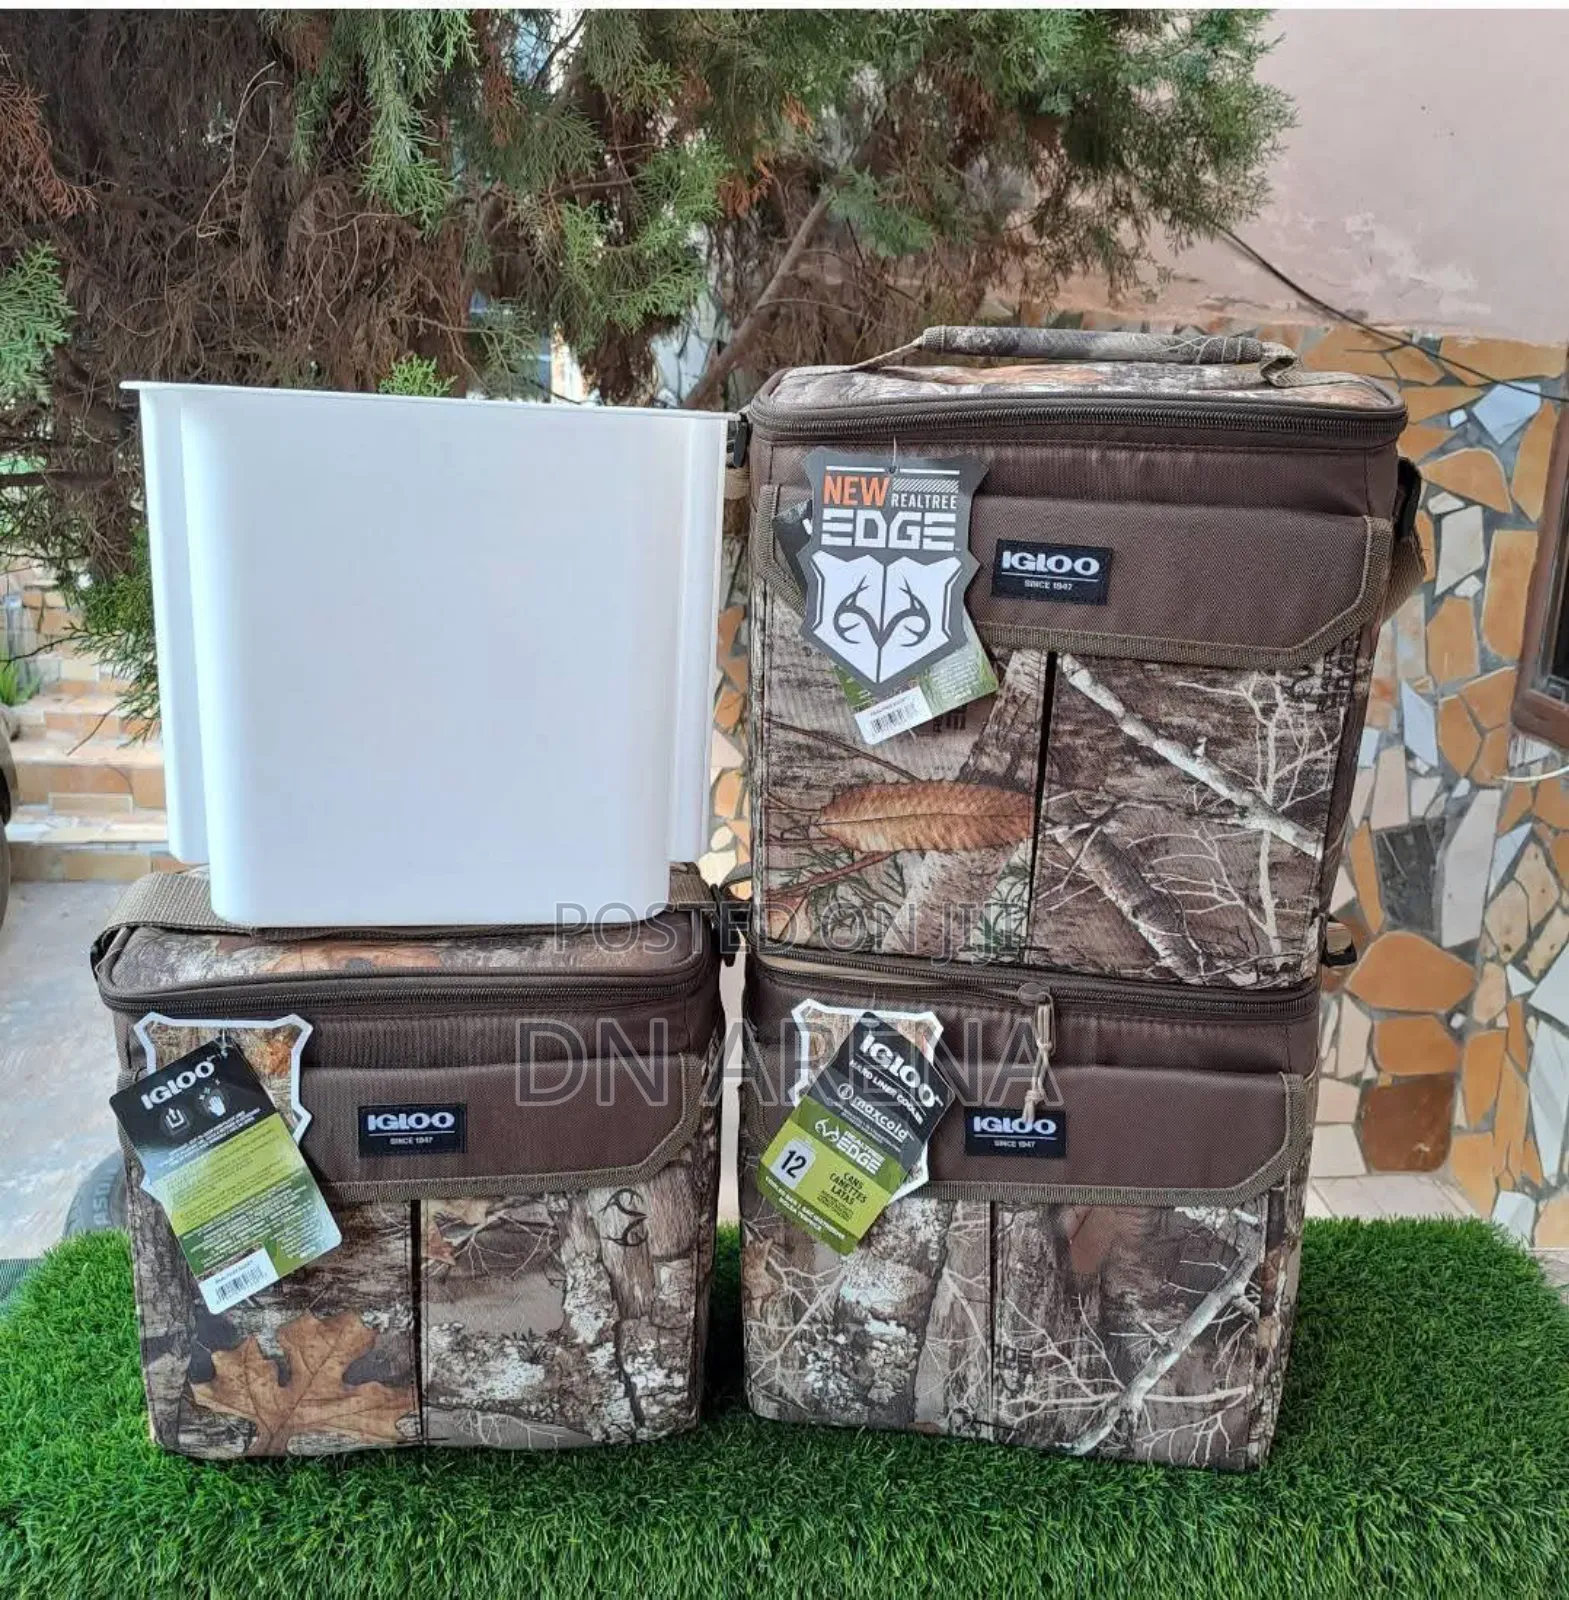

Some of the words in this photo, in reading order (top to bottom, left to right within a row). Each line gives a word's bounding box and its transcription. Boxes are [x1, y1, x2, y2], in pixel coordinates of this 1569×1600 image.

[823, 475, 890, 508] NEW
[891, 492, 957, 509] REALTREE
[820, 508, 957, 551] EDGE
[1002, 551, 1100, 576] IGLOO
[1024, 579, 1050, 589] SINCE
[1053, 582, 1073, 591] 1947
[860, 1033, 935, 1107] IGLOO
[141, 1060, 215, 1110] IGLOO
[849, 1059, 873, 1080] HARD
[872, 1076, 898, 1098] LINER
[896, 1093, 924, 1125] COOLER
[367, 1111, 455, 1131] IGLOO
[973, 1116, 1057, 1135] IGLOO
[390, 1137, 414, 1145] SINCE
[415, 1136, 433, 1144] 1947
[994, 1140, 1017, 1148] SINCE
[781, 1150, 807, 1179] 12
[836, 1137, 882, 1176] EDGE
[829, 1172, 867, 1204] CANETTES
[831, 1184, 855, 1205] LATAS
[843, 1172, 864, 1190] CANS
